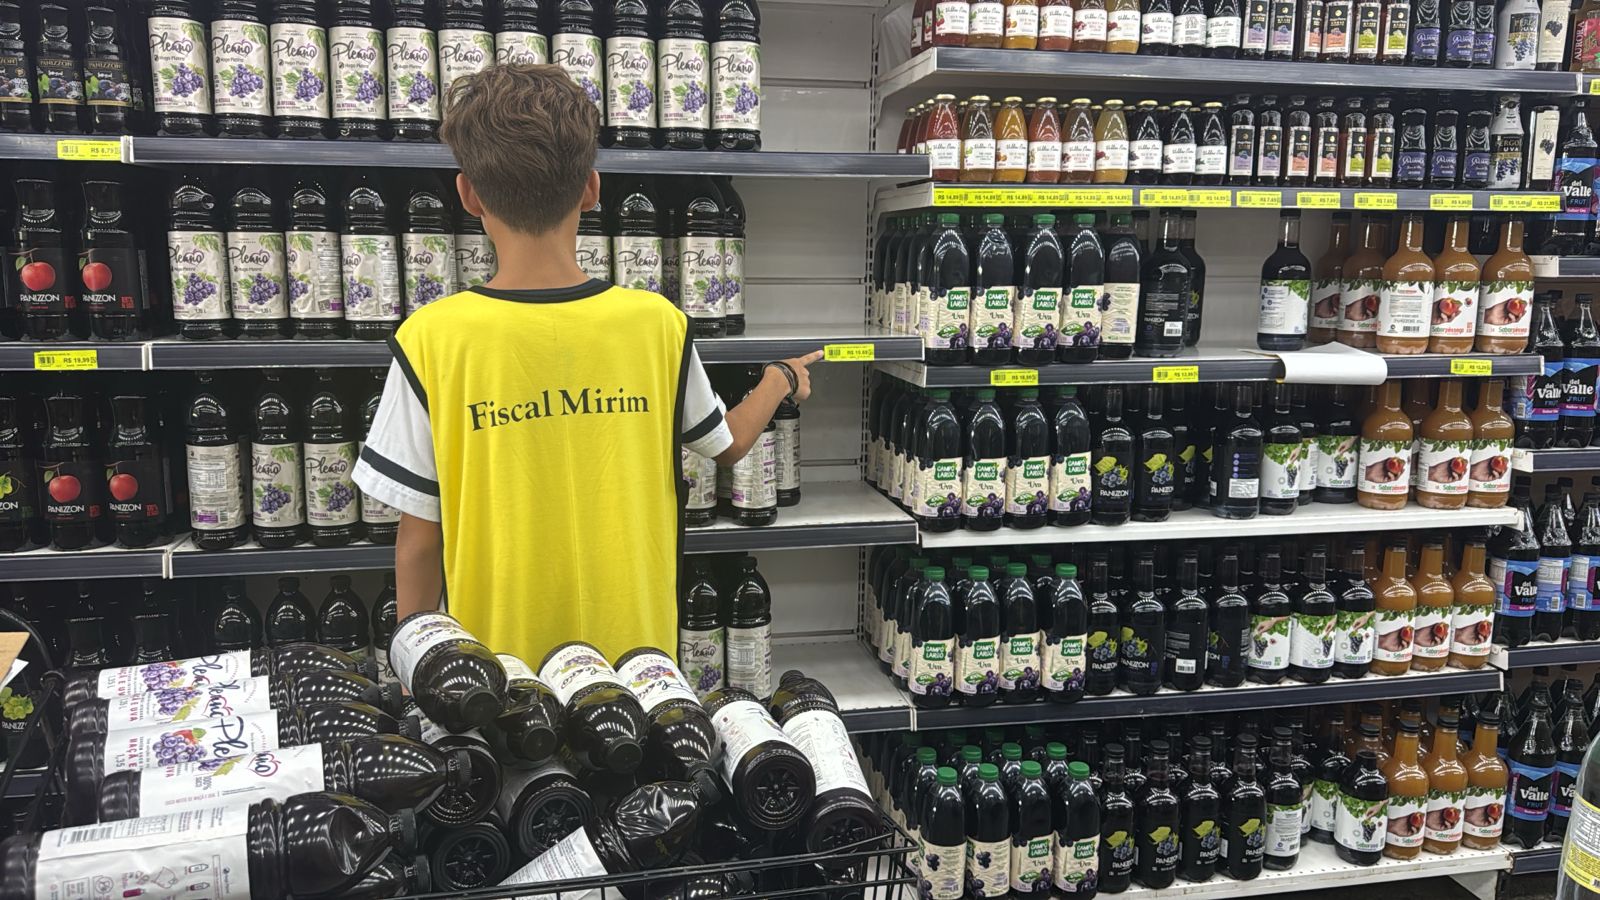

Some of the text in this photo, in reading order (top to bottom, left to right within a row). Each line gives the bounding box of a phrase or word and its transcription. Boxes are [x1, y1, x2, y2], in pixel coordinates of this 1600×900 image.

[1574, 21, 1585, 60] AURORA
[1562, 186, 1592, 197] Valle
[20, 294, 60, 302] PANIZZON
[82, 294, 116, 302] PANIZZON
[1537, 388, 1561, 398] Vall
[1562, 384, 1594, 395] Valle
[467, 388, 649, 431] Fiscal Mirim
[48, 505, 85, 513] PANIZZON
[1013, 639, 1032, 647] CAMPO
[926, 645, 945, 653] CAMPO
[1520, 789, 1549, 801] Valle
